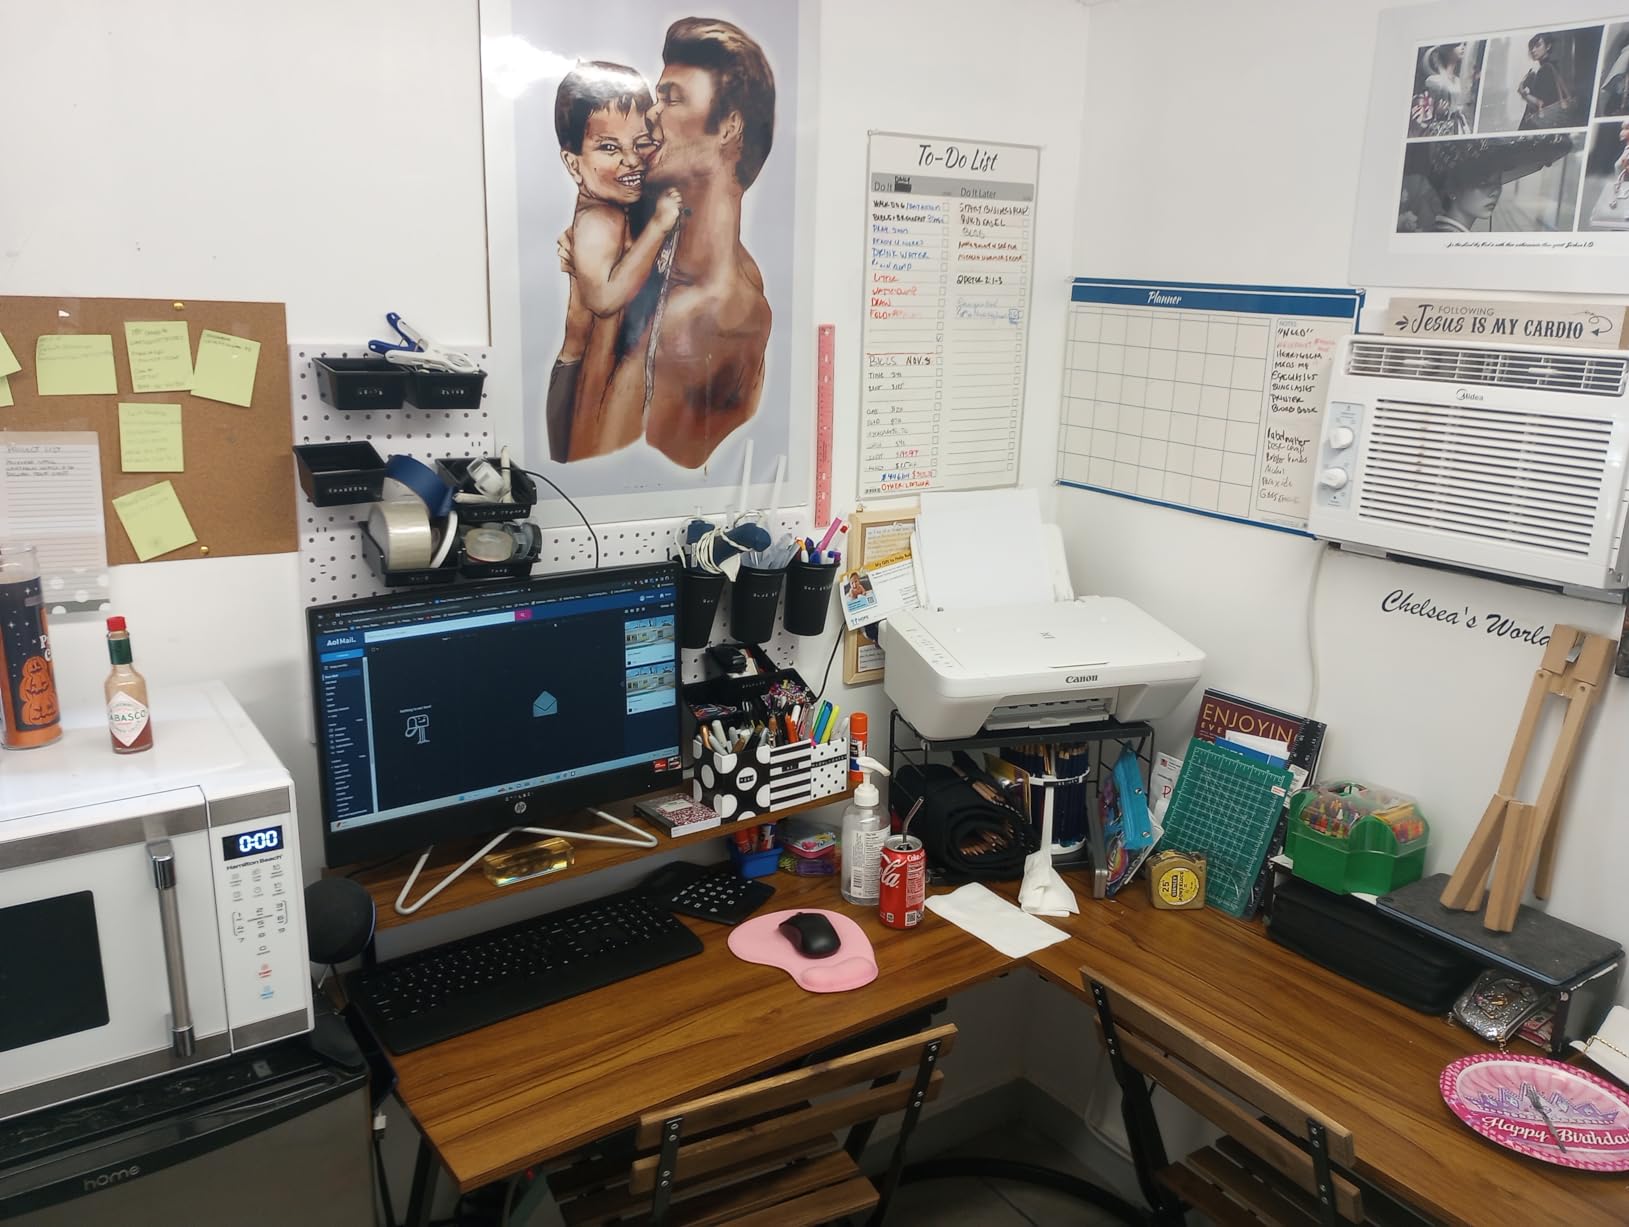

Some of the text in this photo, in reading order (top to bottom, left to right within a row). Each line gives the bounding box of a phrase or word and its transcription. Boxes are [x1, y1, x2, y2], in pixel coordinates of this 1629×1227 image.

[918, 144, 998, 173] To-Do List
[874, 182, 893, 192] Do It
[960, 187, 971, 197] Do
[978, 189, 997, 199] Later
[1147, 290, 1182, 306] Planner
[1438, 305, 1495, 317] FOLLOWING
[1411, 303, 1584, 340] Jesus IS MY CARDIO
[1456, 389, 1484, 401] Midea
[1381, 589, 1477, 629] Chelsea's
[326, 639, 339, 647] Aol
[1065, 673, 1099, 684] Canon
[1200, 721, 1223, 734] EVE
[1201, 703, 1299, 744] ENJOYIN
[239, 830, 278, 852] 0:00
[226, 855, 283, 870] Hamilton Beach
[1482, 1116, 1550, 1142] Happy
[84, 1163, 140, 1191] home
